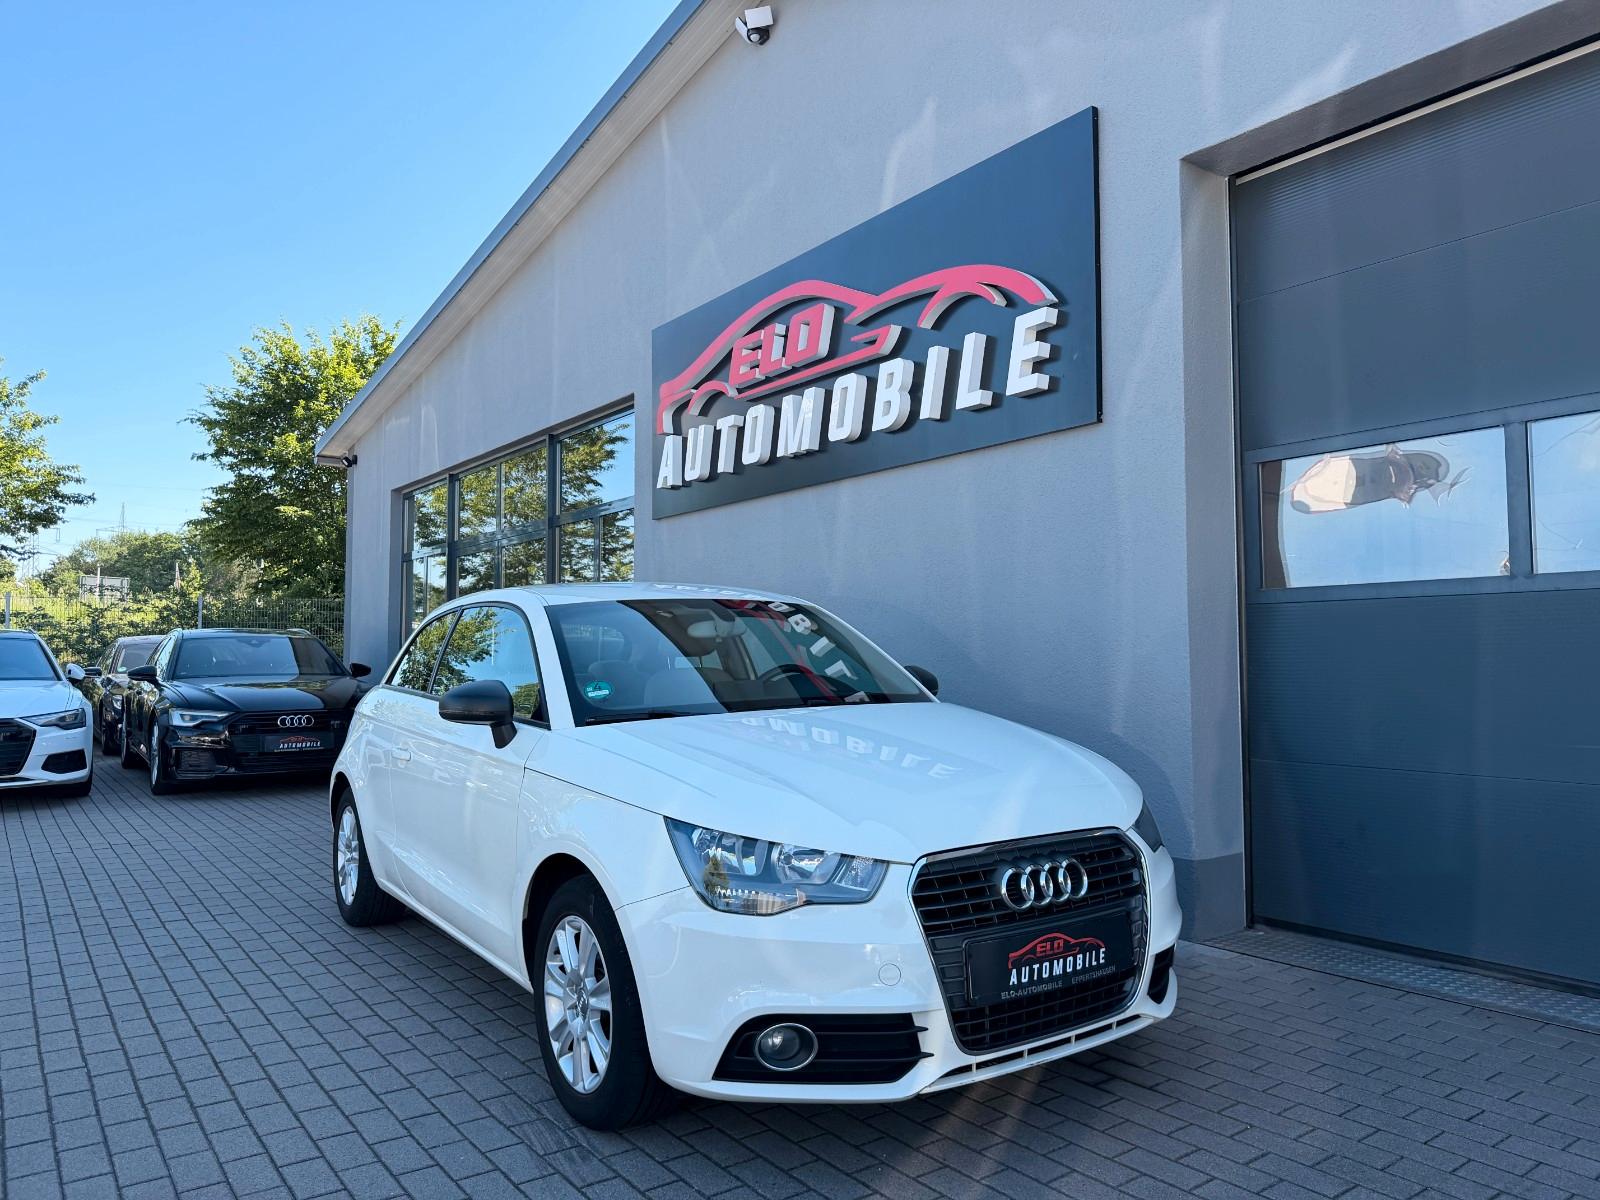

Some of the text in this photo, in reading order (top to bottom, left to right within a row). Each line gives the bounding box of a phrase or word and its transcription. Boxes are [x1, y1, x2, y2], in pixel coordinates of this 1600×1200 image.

[729, 303, 835, 387] ELO
[657, 307, 1059, 489] AUTOMOBILE
[280, 741, 320, 749] AUTOMOBILE
[1036, 939, 1064, 957] ELO
[1009, 948, 1106, 986] AUTOMOBILE
[1001, 980, 1063, 1000] ELO-AUTOMOBILE
